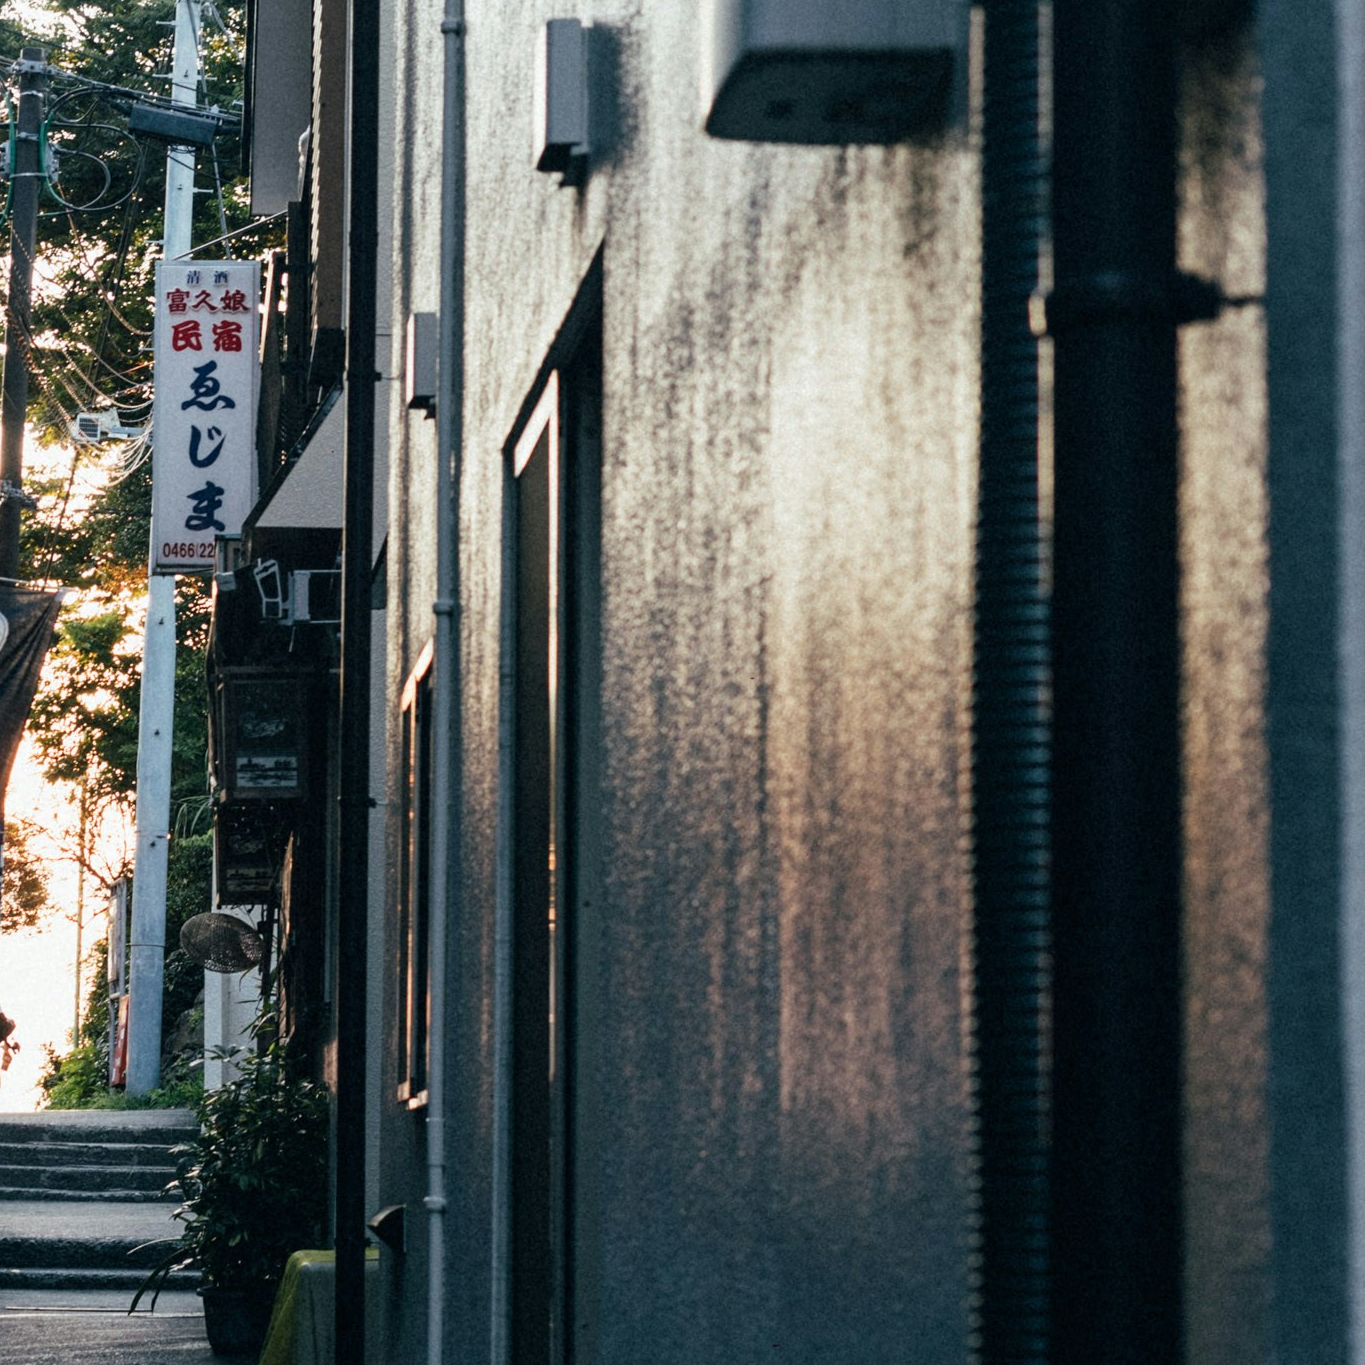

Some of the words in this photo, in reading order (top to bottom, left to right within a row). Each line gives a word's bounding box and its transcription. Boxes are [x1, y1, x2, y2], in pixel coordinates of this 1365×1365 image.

[187, 270, 228, 285] 清酒
[167, 288, 249, 313] 富久娘
[172, 320, 242, 353] 民宿
[181, 360, 236, 532] ゑじま
